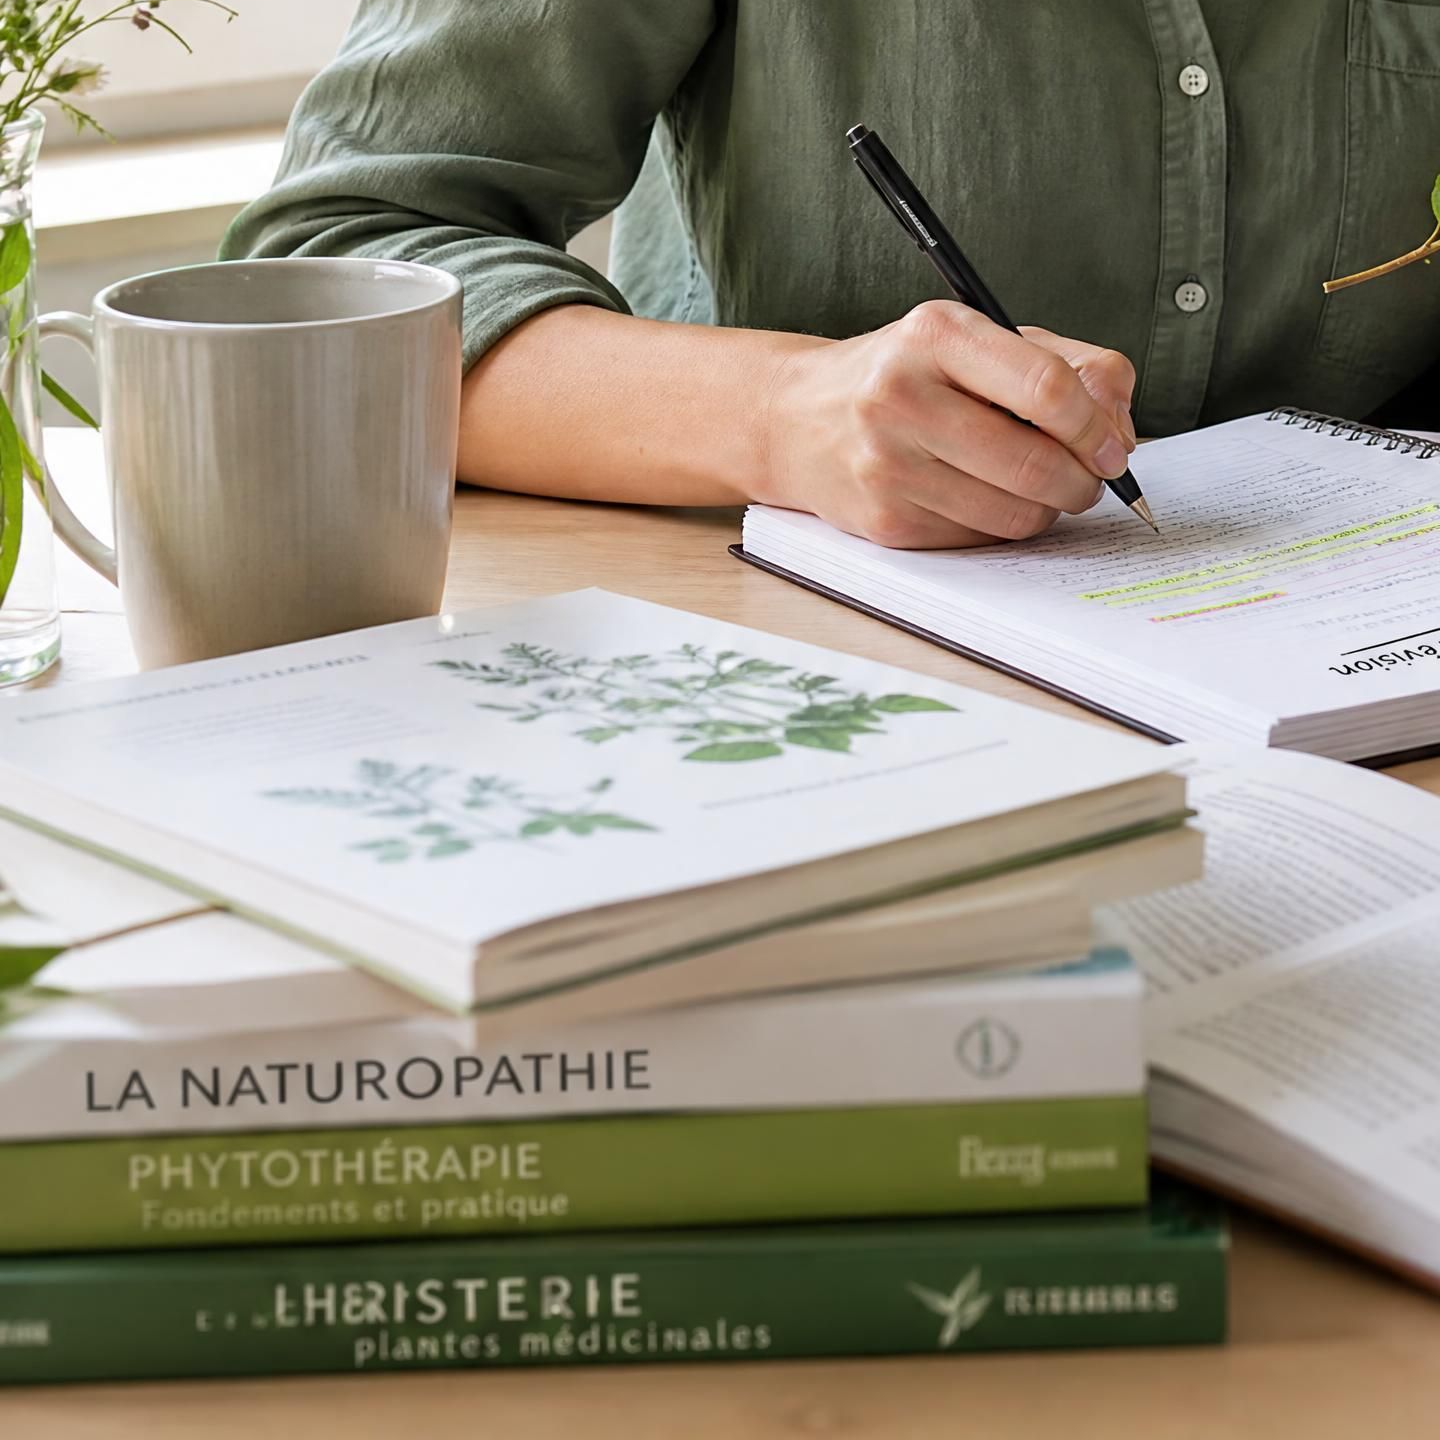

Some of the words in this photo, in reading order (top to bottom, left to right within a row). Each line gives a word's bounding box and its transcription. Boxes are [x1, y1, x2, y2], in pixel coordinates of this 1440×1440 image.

[85, 1070, 157, 1113] LA
[180, 1049, 652, 1109] NATUROPATHIE
[128, 1137, 542, 1192] PHYTOTHÉRAPIE
[141, 1197, 360, 1231] Fondements
[372, 1196, 407, 1223] et
[420, 1188, 571, 1227] pratique
[353, 1326, 502, 1369] plantes
[520, 1316, 772, 1357] médicinales
